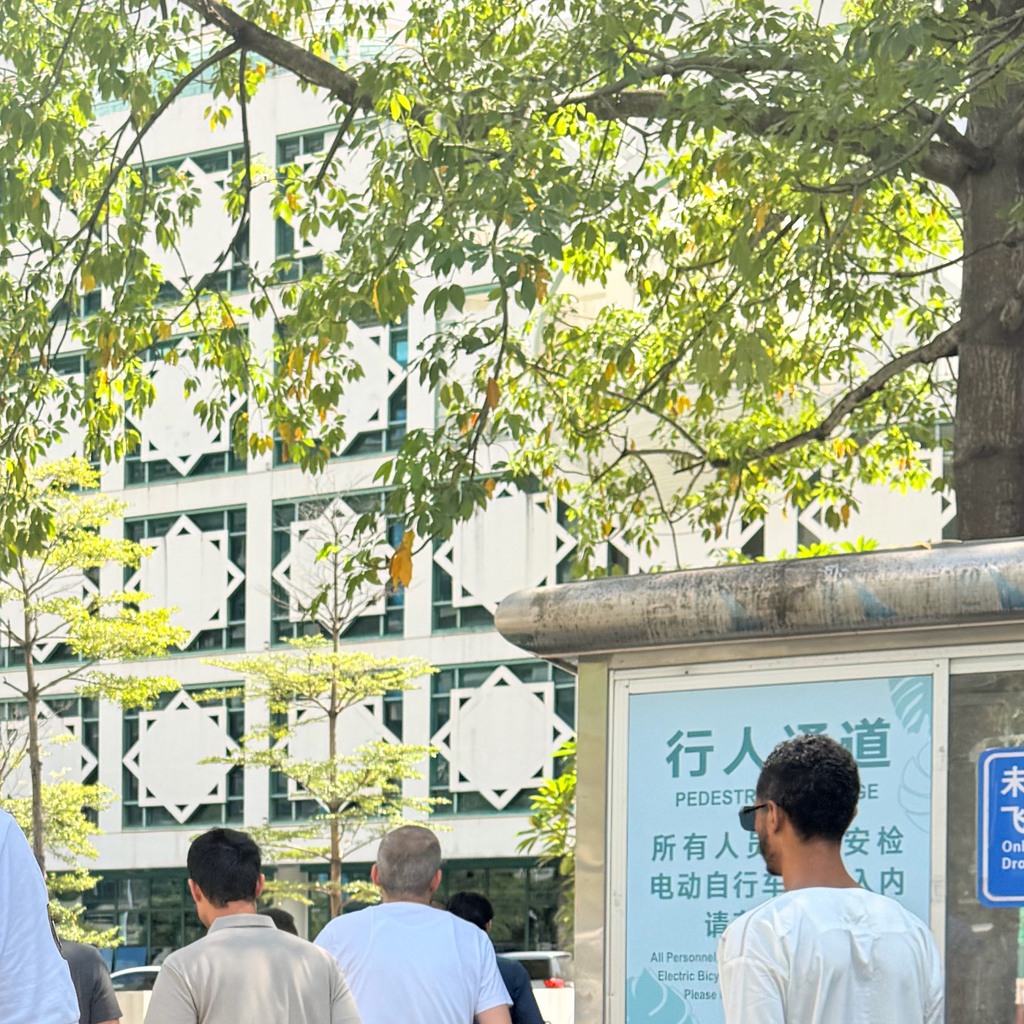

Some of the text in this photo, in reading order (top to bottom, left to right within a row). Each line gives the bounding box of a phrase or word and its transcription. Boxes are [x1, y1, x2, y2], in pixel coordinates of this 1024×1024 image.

[665, 717, 891, 778] 行人道
[1000, 765, 1024, 798] 未
[675, 788, 757, 807] PEDESTR
[1000, 806, 1024, 834] 飞
[1001, 840, 1024, 853] Onl
[1001, 857, 1024, 870] Dro
[650, 867, 904, 900] 电动自行车入内
[650, 951, 717, 963] All Personnel
[657, 970, 720, 984] Electric Bicy
[683, 989, 718, 1000] Please
